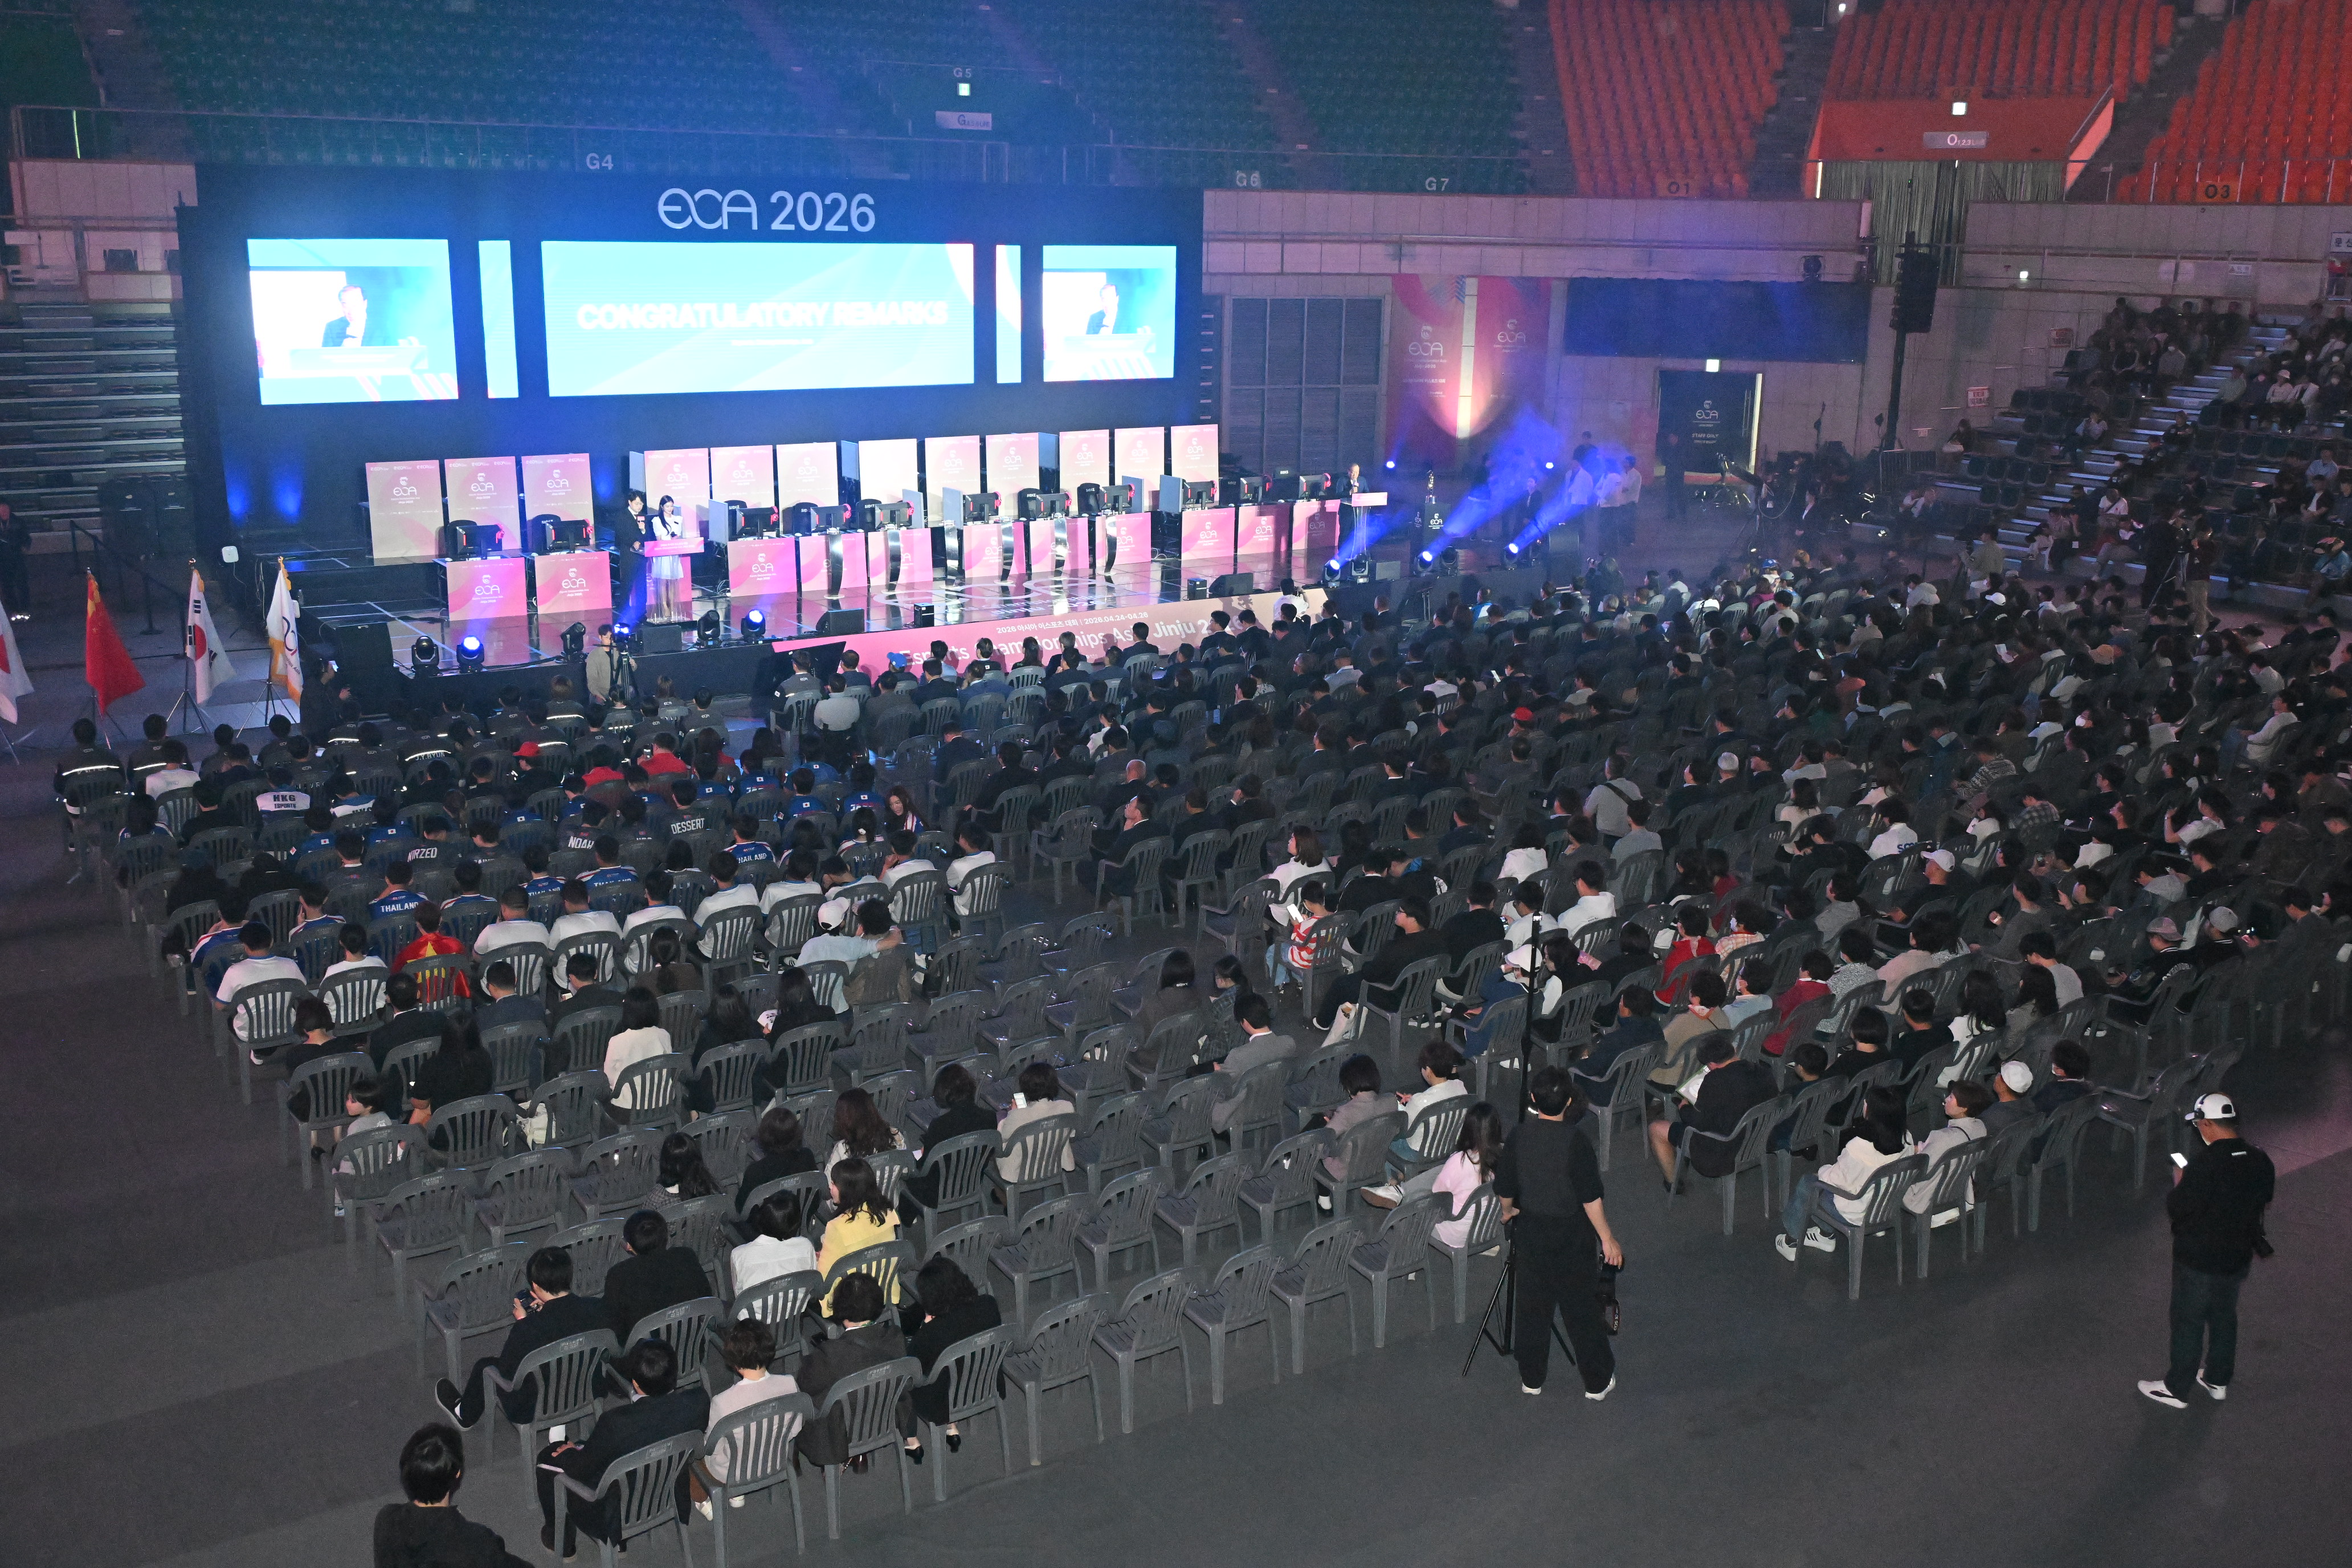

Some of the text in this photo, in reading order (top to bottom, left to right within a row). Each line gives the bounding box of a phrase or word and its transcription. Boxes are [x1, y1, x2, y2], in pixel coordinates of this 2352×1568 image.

[586, 152, 614, 170] G4
[1236, 172, 1259, 187] G6
[1425, 177, 1449, 191] G7
[2204, 184, 2231, 199] O3
[658, 188, 876, 232] ECA 2026
[577, 300, 948, 330] CONGRATULATORY REMARKS
[1409, 342, 1443, 356] ECA
[1696, 410, 1718, 419] ECA
[471, 483, 494, 492] ECA
[547, 479, 569, 488] ECA
[393, 487, 417, 496] ECA
[1199, 530, 1217, 539] ECA
[1255, 525, 1272, 534] ECA
[752, 562, 774, 573] ECA
[562, 578, 586, 589] ECA
[475, 585, 500, 595] ECA
[1018, 623, 1038, 632] 아시아
[1038, 620, 1065, 630] 이스포츠
[1065, 618, 1078, 627] 대회
[1084, 612, 1149, 625] 2026.04.24-04.26
[1153, 620, 1196, 639] Jinju
[671, 818, 705, 835] DESSERT
[380, 902, 419, 913] THAILAND
